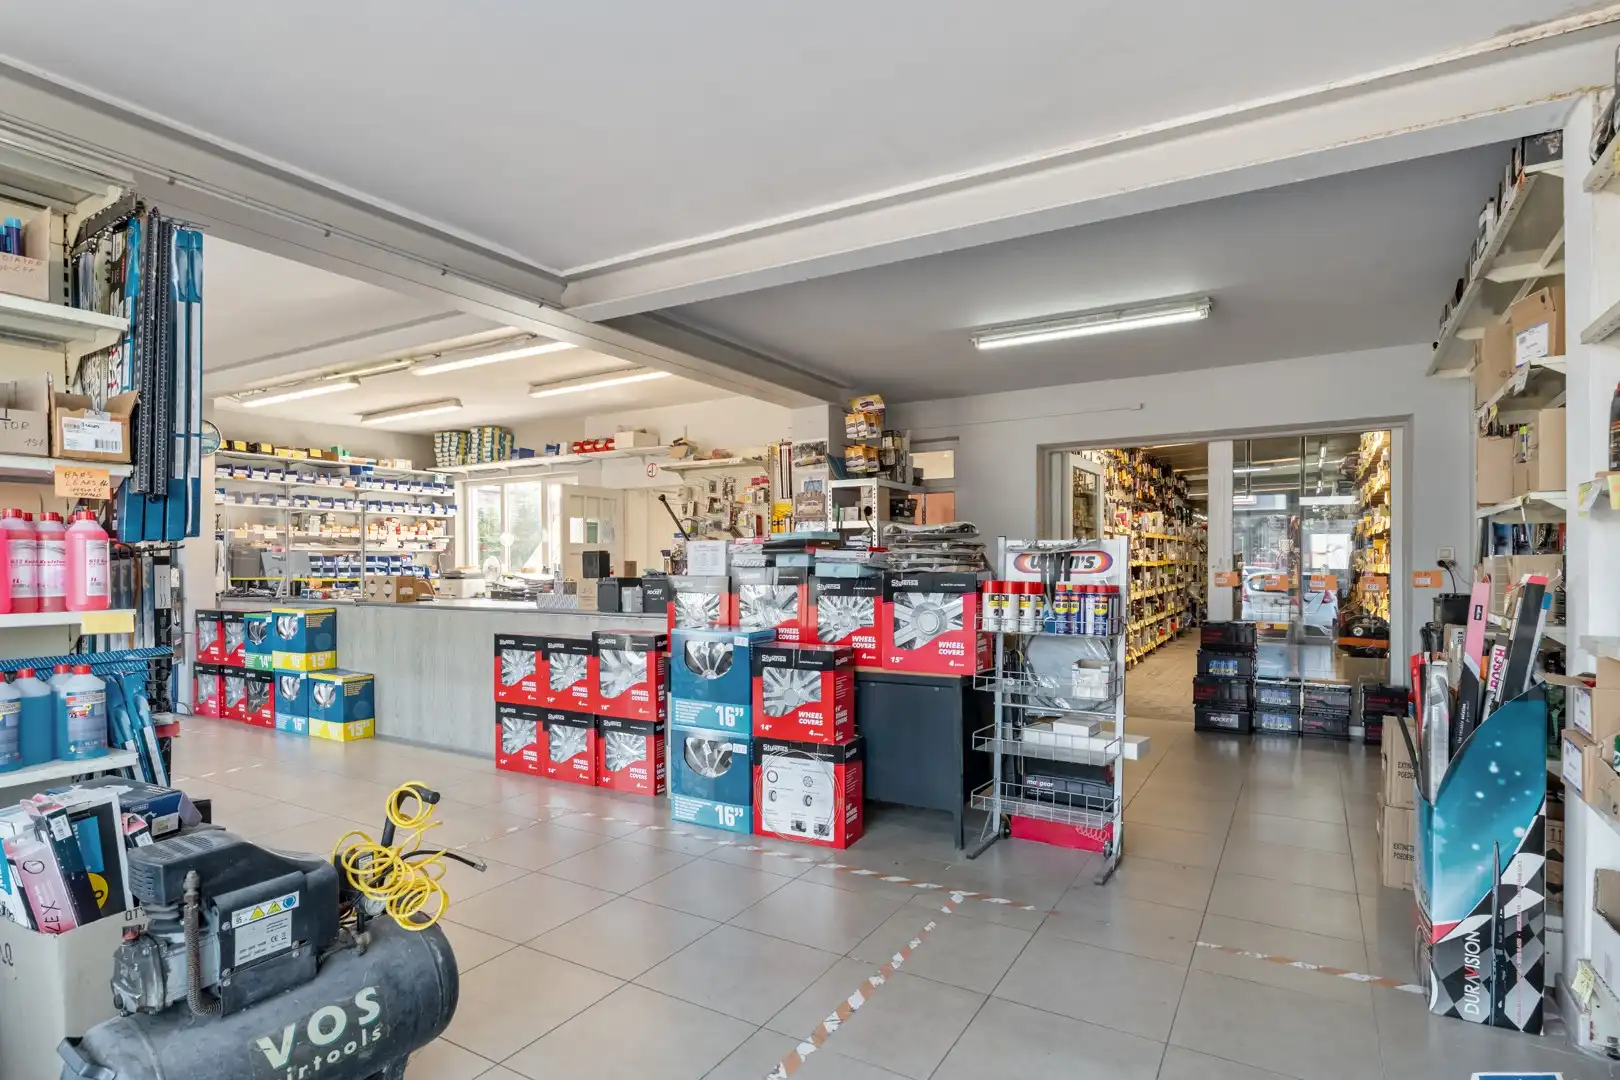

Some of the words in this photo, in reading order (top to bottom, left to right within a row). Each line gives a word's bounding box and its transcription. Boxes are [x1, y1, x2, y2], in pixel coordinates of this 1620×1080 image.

[938, 641, 964, 650] WHEEL
[938, 648, 964, 656] COVERS
[1490, 647, 1505, 690] BOSCH
[798, 711, 823, 719] WHEEL
[798, 718, 823, 726] COVERS
[1397, 762, 1415, 771] EXTIN
[1464, 930, 1480, 1015] DURAVISION
[256, 986, 381, 1069] VOS
